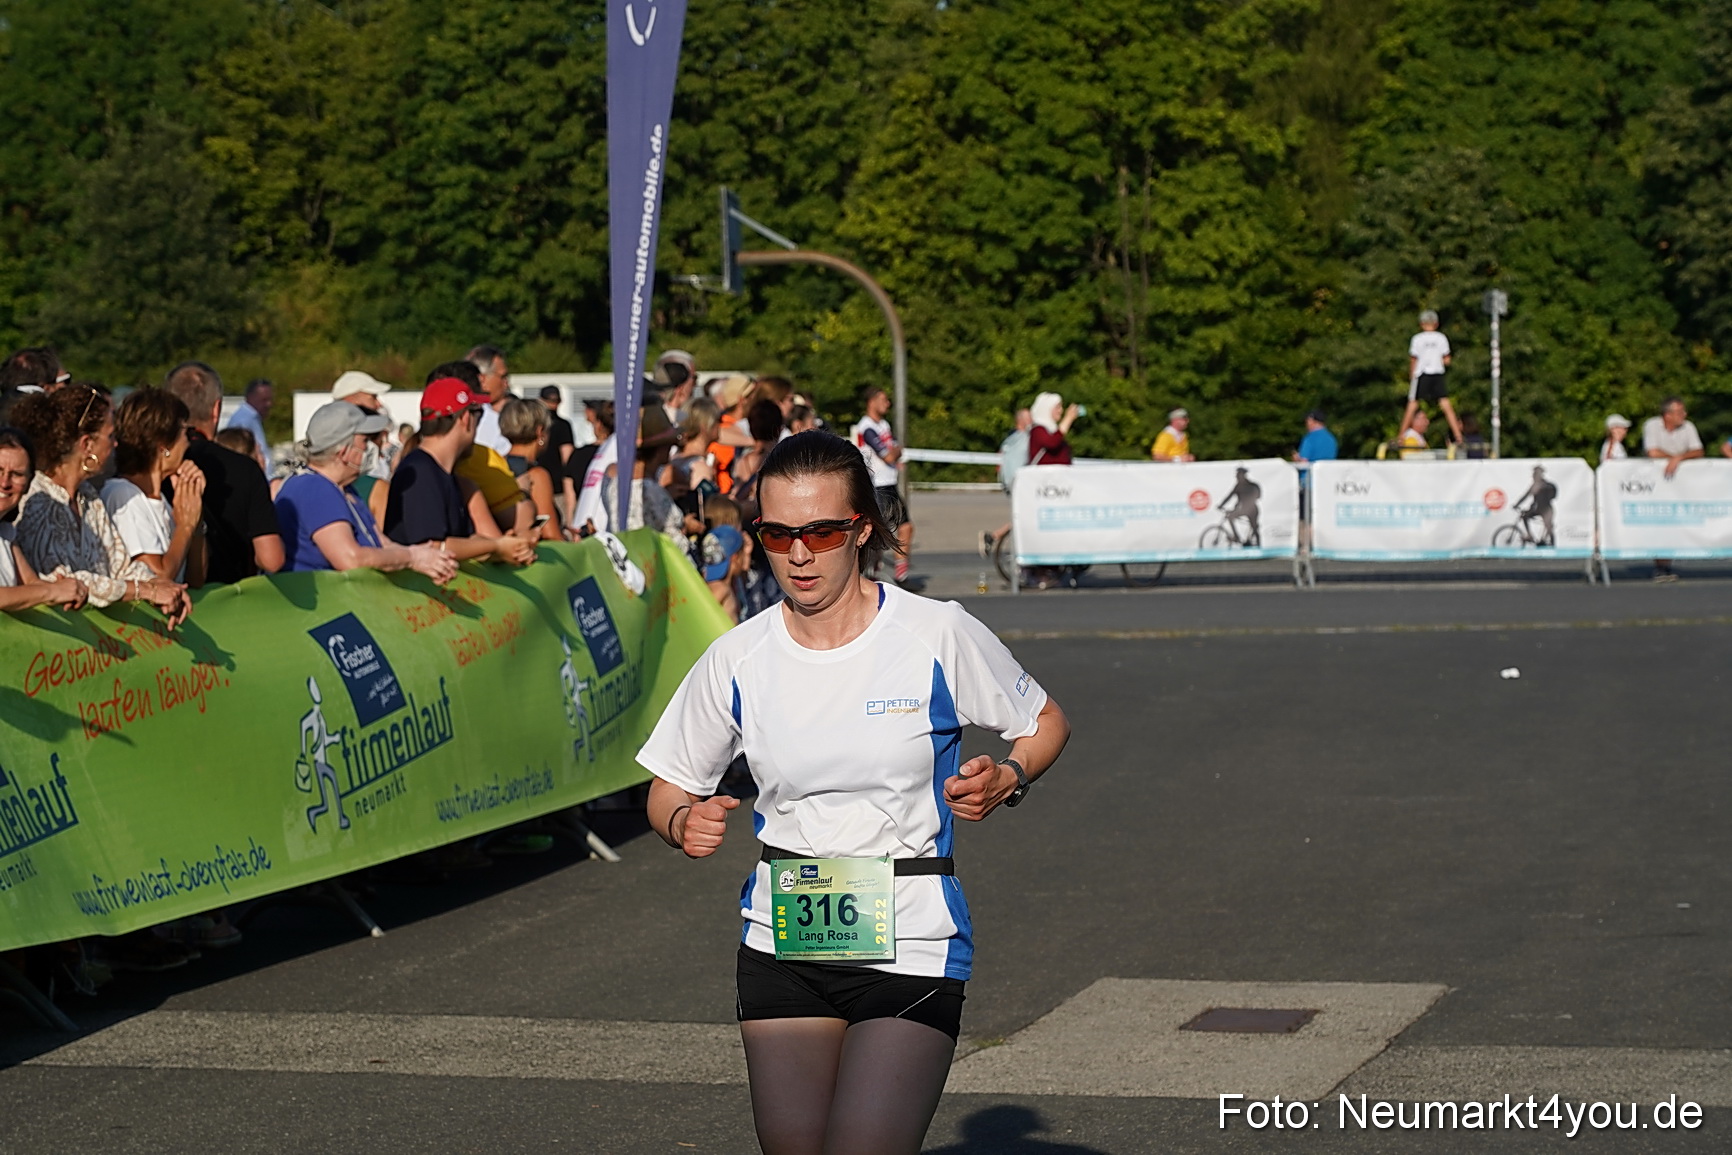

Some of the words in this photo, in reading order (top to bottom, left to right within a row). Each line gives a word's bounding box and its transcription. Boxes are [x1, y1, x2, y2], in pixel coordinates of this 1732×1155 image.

[24, 624, 128, 698] Gesunde
[339, 643, 376, 671] Fischer
[156, 646, 230, 714] länger!
[78, 677, 153, 741] laufen
[886, 698, 920, 708] PETTER
[340, 676, 454, 794] firmenlauf
[355, 770, 407, 818] neumarkt
[795, 876, 834, 886] Firmenlauf
[777, 905, 788, 940] RUN
[796, 893, 859, 927] 316
[874, 898, 887, 945] 2022
[798, 930, 824, 944] Lang
[827, 930, 858, 942] Rosa
